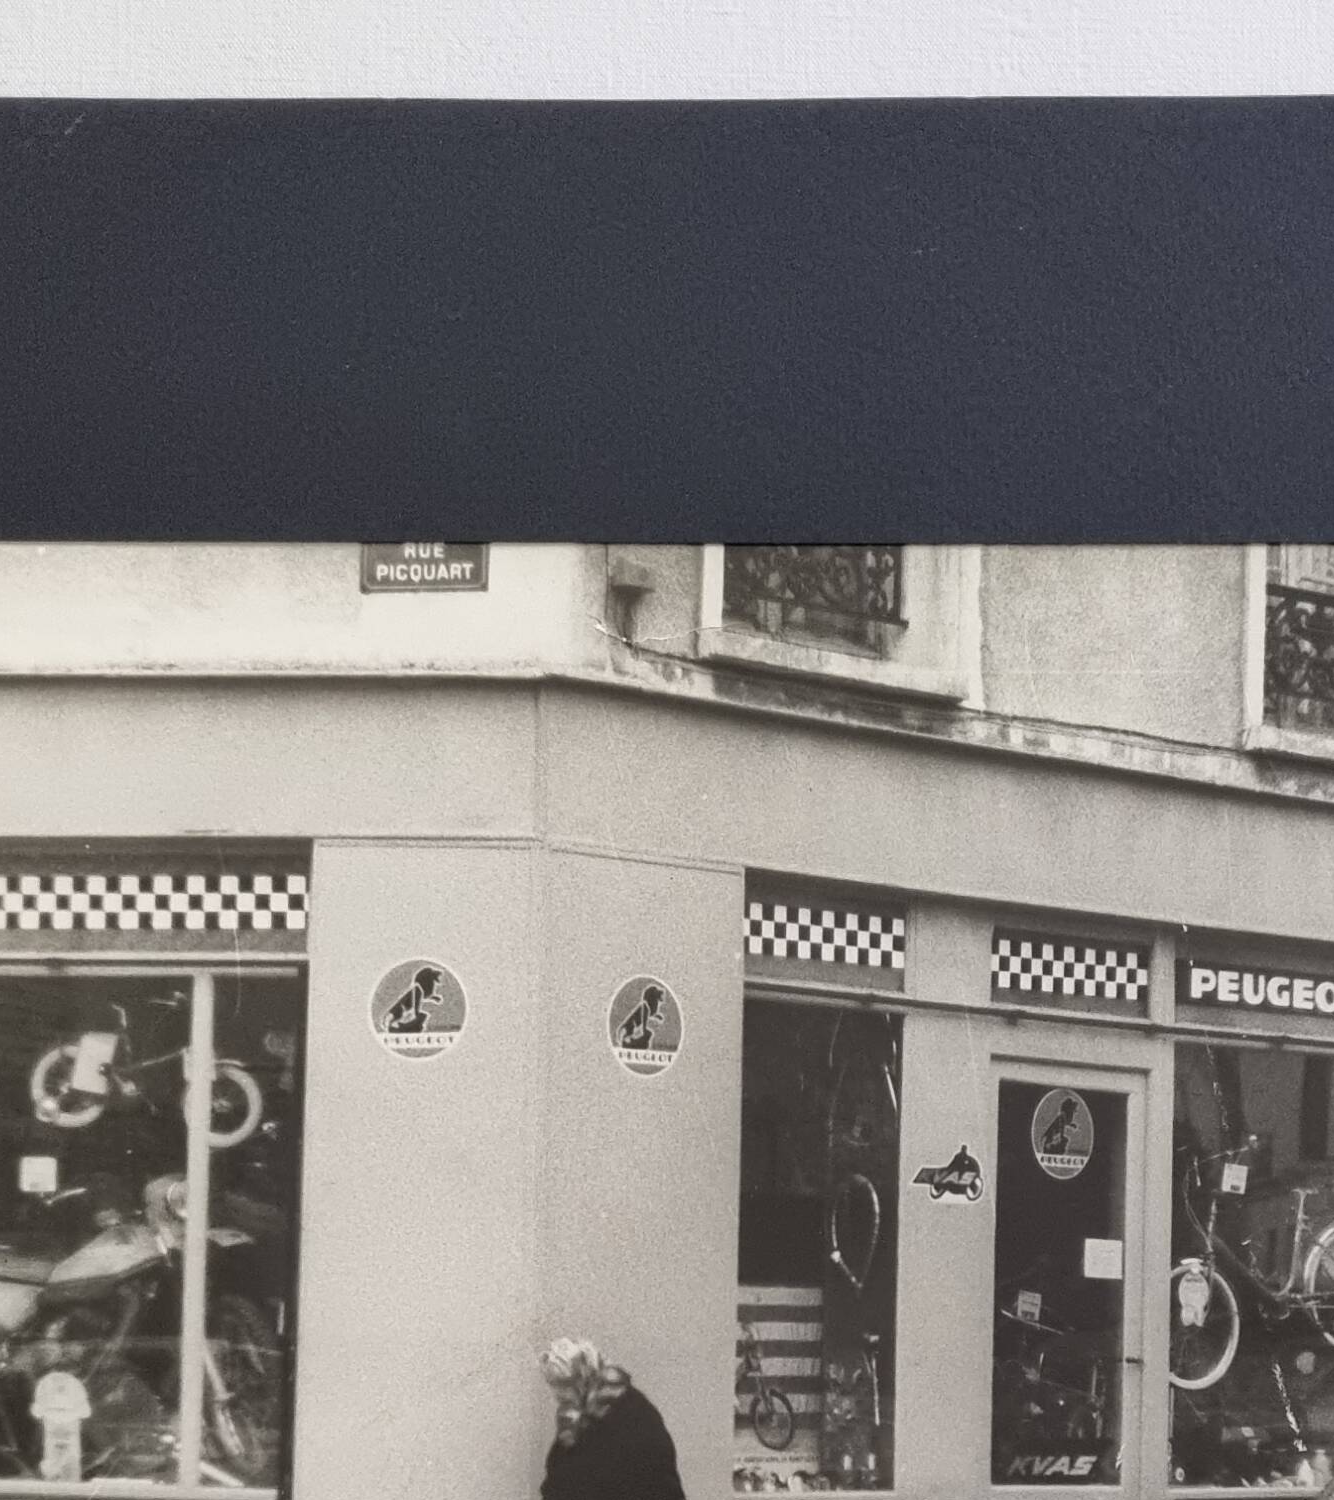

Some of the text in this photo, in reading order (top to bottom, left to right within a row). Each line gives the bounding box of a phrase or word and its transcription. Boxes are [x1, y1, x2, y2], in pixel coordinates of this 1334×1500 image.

[403, 542, 445, 559] RUE
[376, 563, 474, 582] PICQUART
[1008, 1455, 1098, 1476] KVAS
